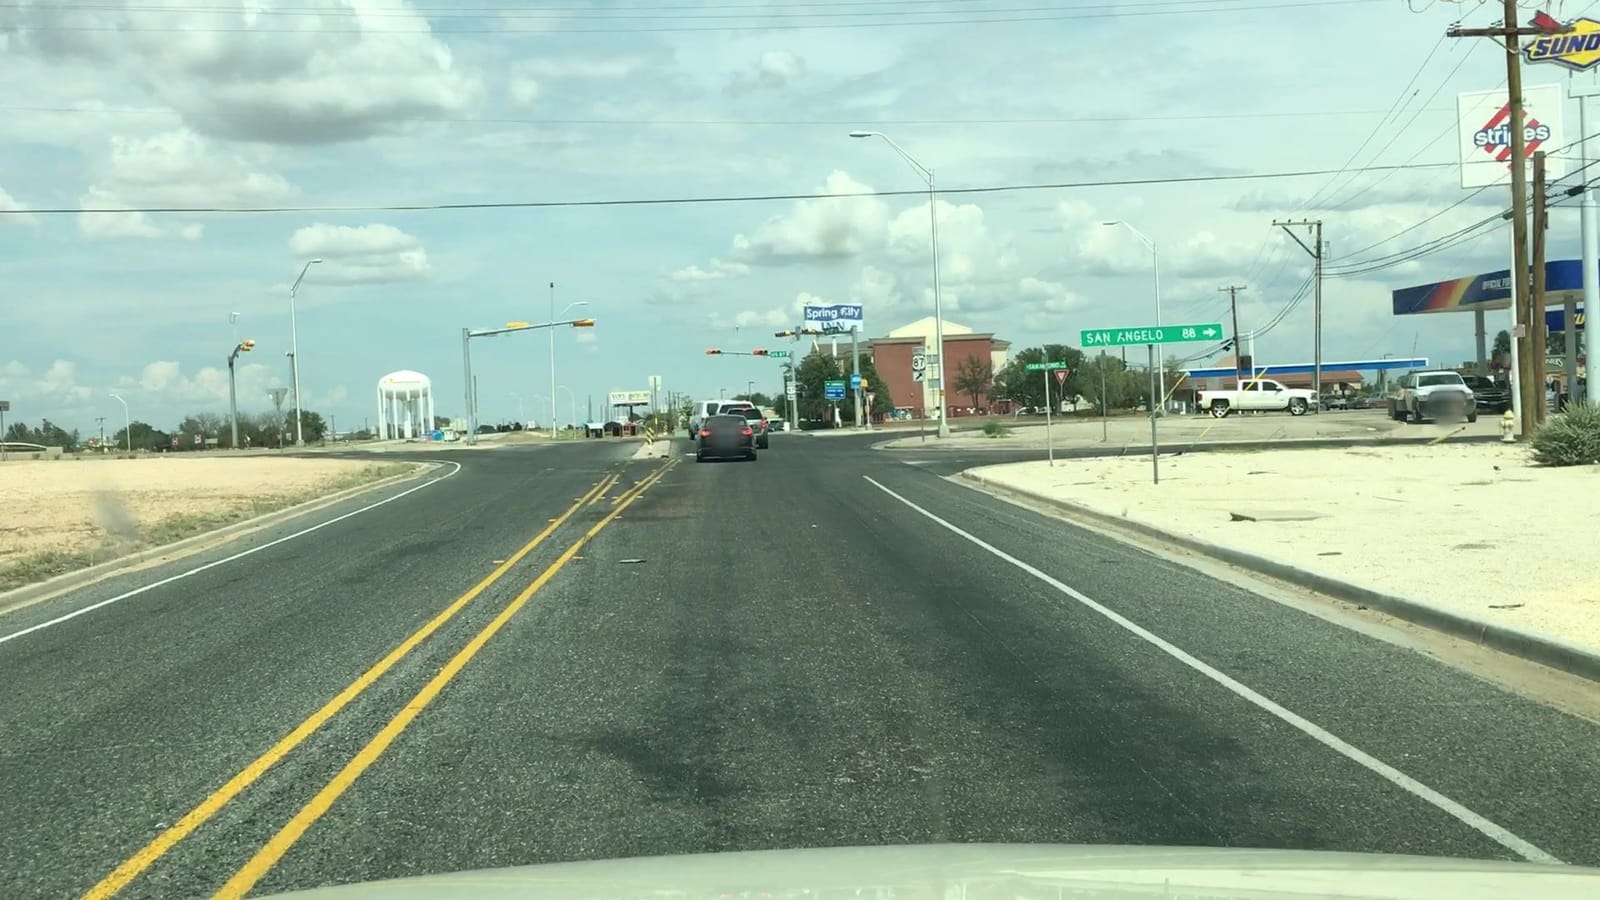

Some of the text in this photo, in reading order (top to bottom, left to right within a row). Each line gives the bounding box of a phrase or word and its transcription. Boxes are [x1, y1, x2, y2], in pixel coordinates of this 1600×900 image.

[1475, 125, 1549, 146] stries
[807, 307, 860, 319] Spring City
[821, 321, 844, 330] INN
[1086, 328, 1196, 343] SAN ANGELO 88
[914, 357, 924, 367] 87
